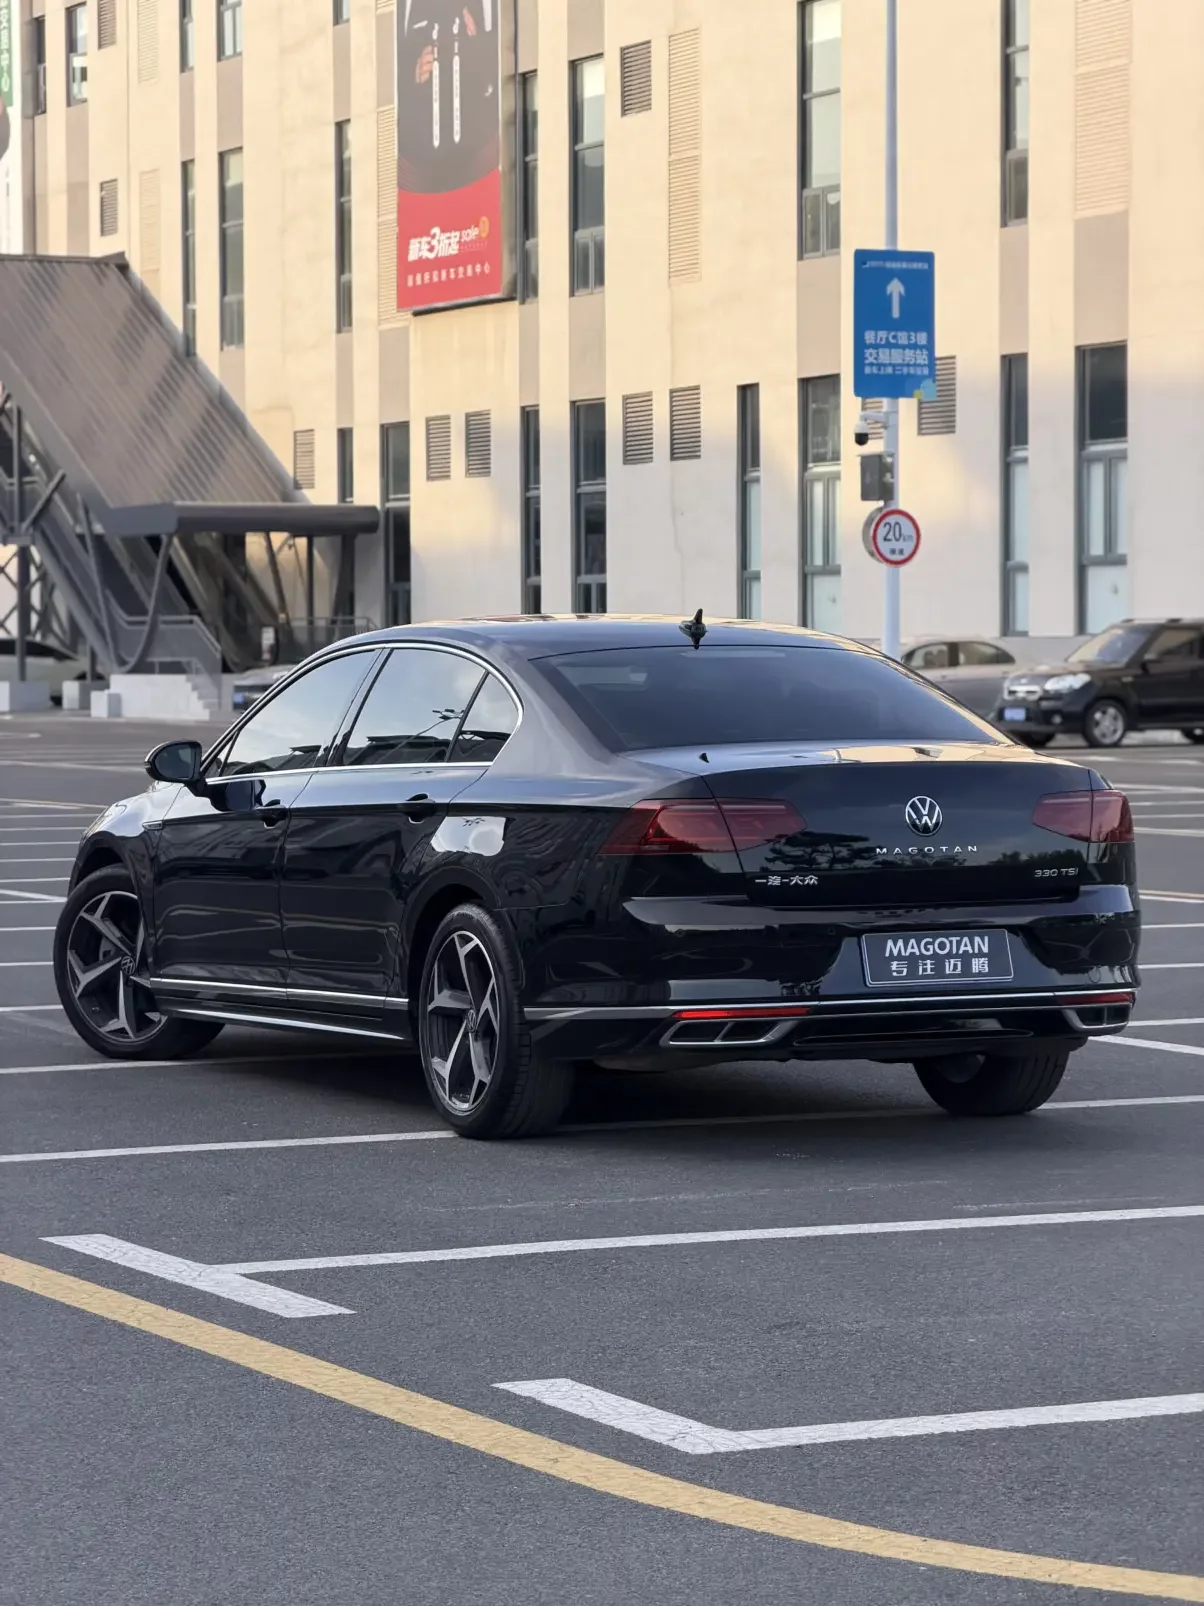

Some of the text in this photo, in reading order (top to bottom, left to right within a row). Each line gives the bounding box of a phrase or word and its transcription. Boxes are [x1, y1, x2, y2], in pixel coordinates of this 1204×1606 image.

[876, 845, 978, 855] MAGOTAN
[1034, 867, 1079, 877] 330 TSI
[885, 936, 989, 957] MAGOTAN
[890, 958, 989, 977] 专注迈腾
